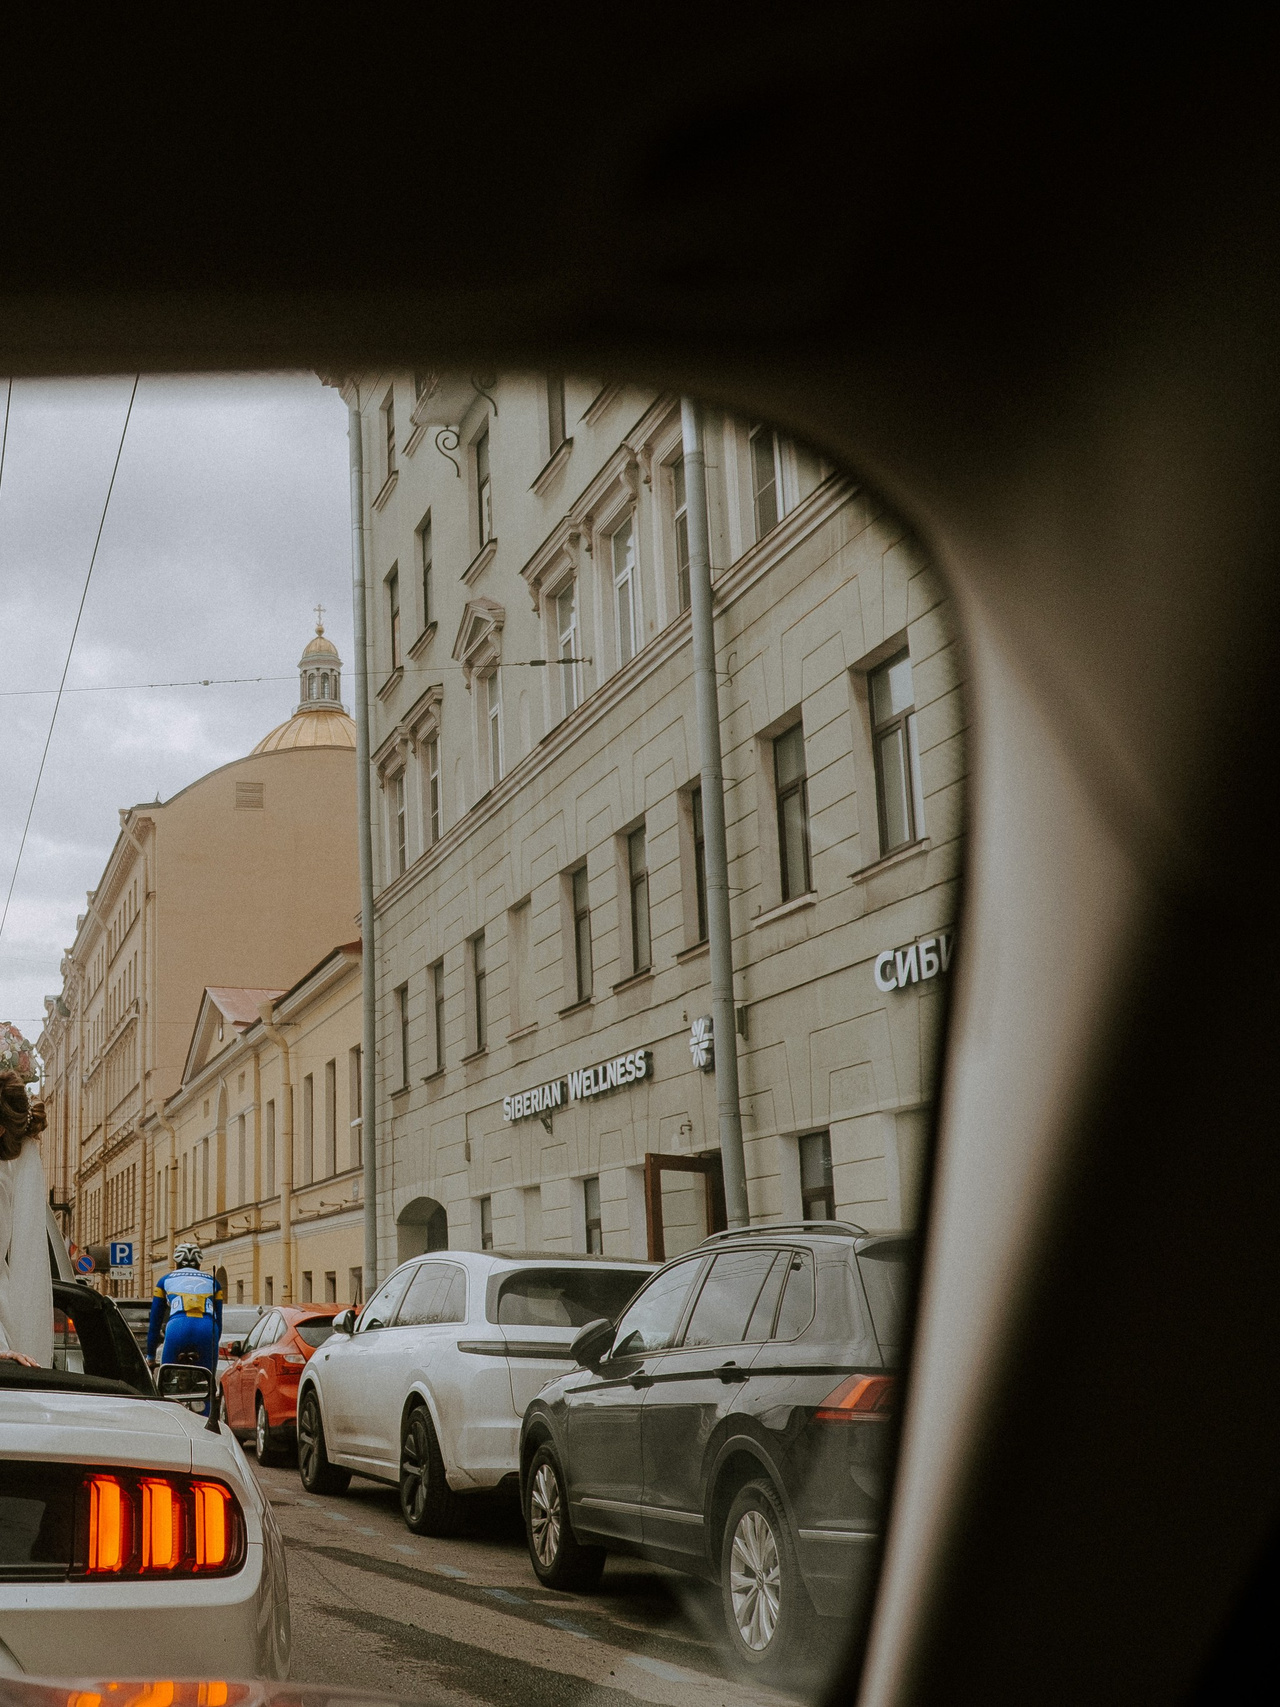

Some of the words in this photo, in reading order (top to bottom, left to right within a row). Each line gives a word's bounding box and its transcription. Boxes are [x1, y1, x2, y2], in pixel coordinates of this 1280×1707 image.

[503, 1081, 561, 1121] SIBERIAN
[568, 1050, 647, 1100] WELLNESS
[116, 1244, 129, 1263] P
